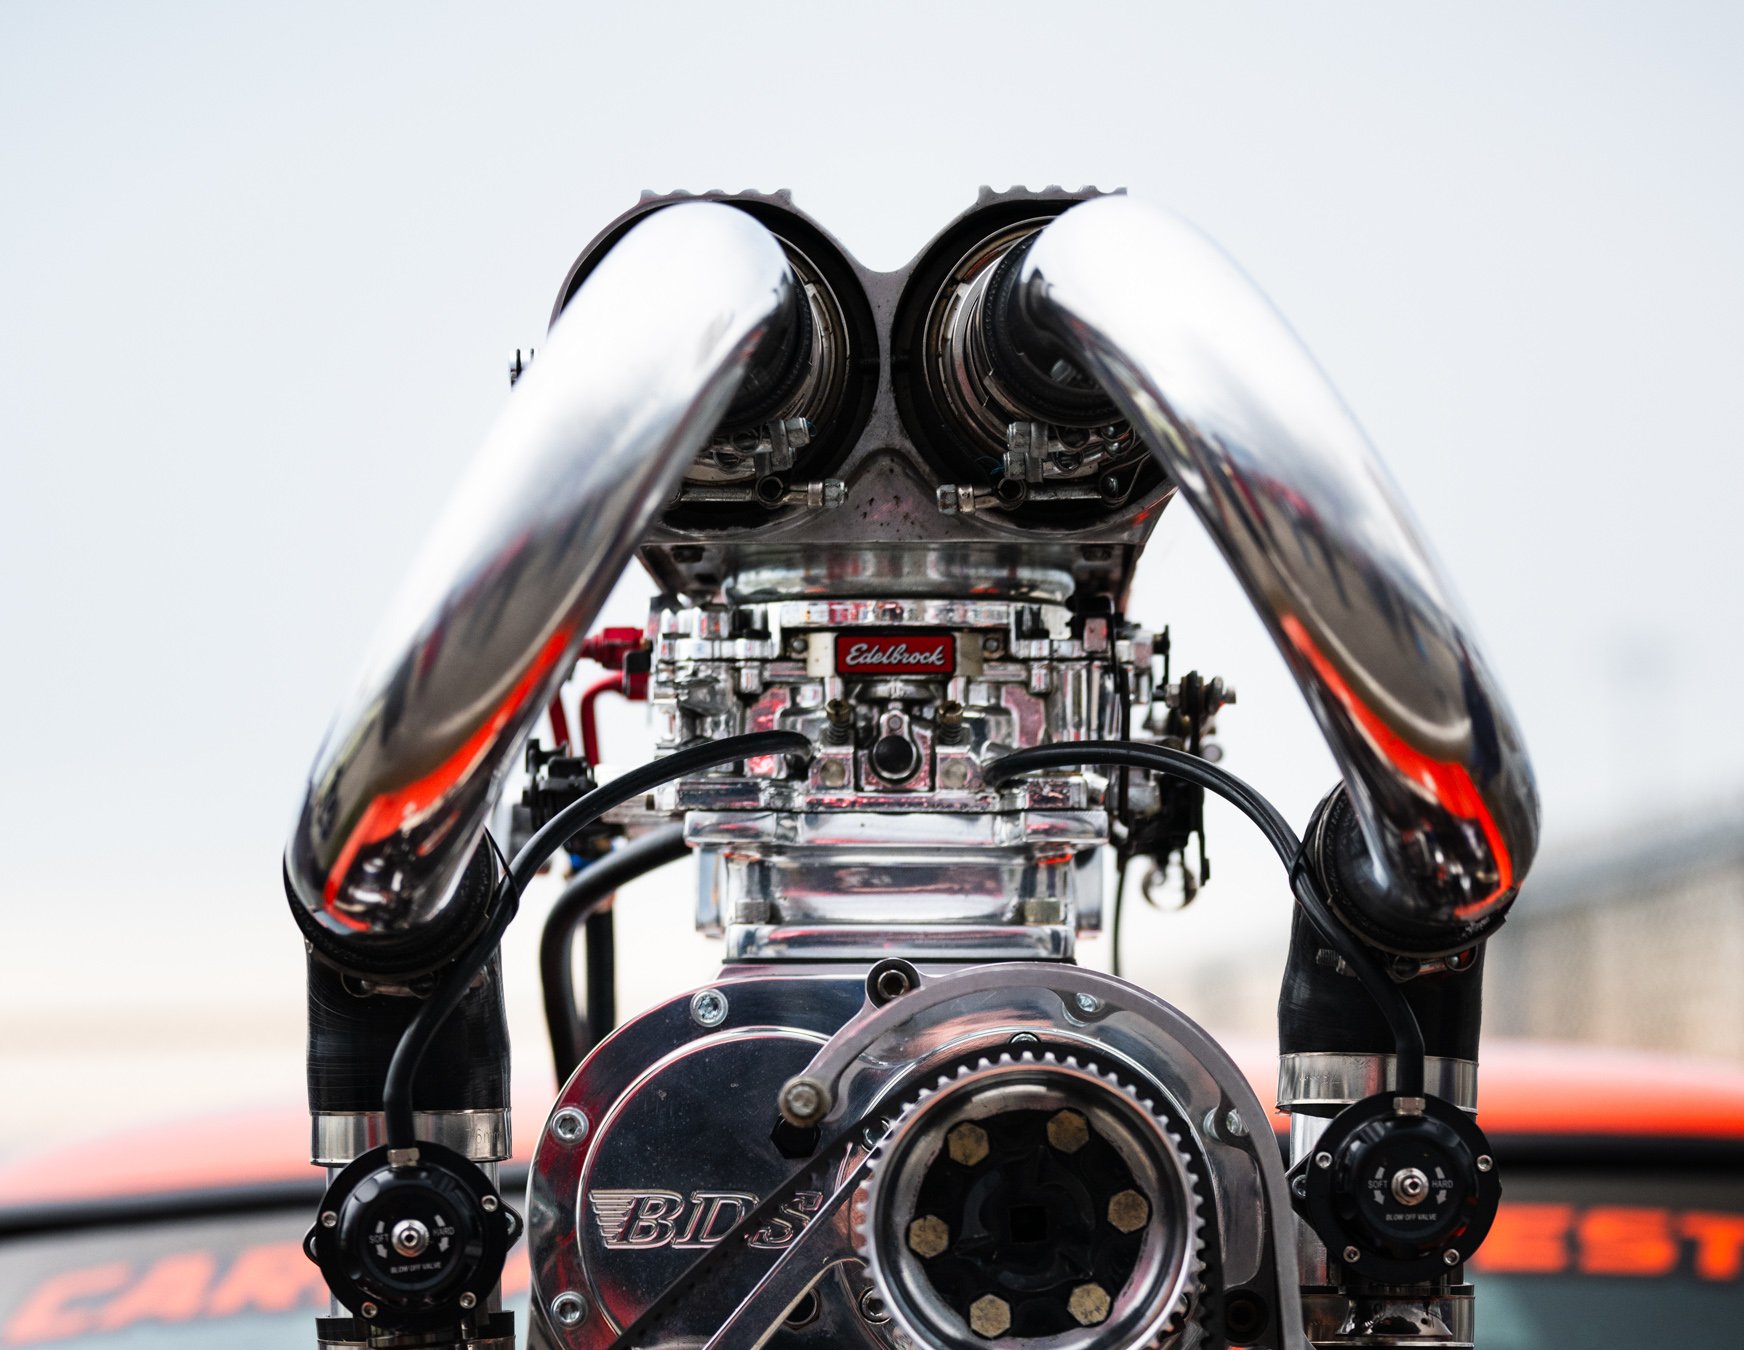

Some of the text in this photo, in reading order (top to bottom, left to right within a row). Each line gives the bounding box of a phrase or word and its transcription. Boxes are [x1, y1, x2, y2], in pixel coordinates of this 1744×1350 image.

[845, 642, 945, 666] Edelbrock
[1367, 1179, 1388, 1189] SOFT
[1431, 1179, 1454, 1188] HARD
[589, 1188, 824, 1250] BDS
[1385, 1213, 1437, 1221] BLOW OFF VALVE
[432, 1226, 455, 1237] HARD
[368, 1233, 390, 1245] SOFT
[390, 1261, 442, 1275] BLOW OFF VALVE
